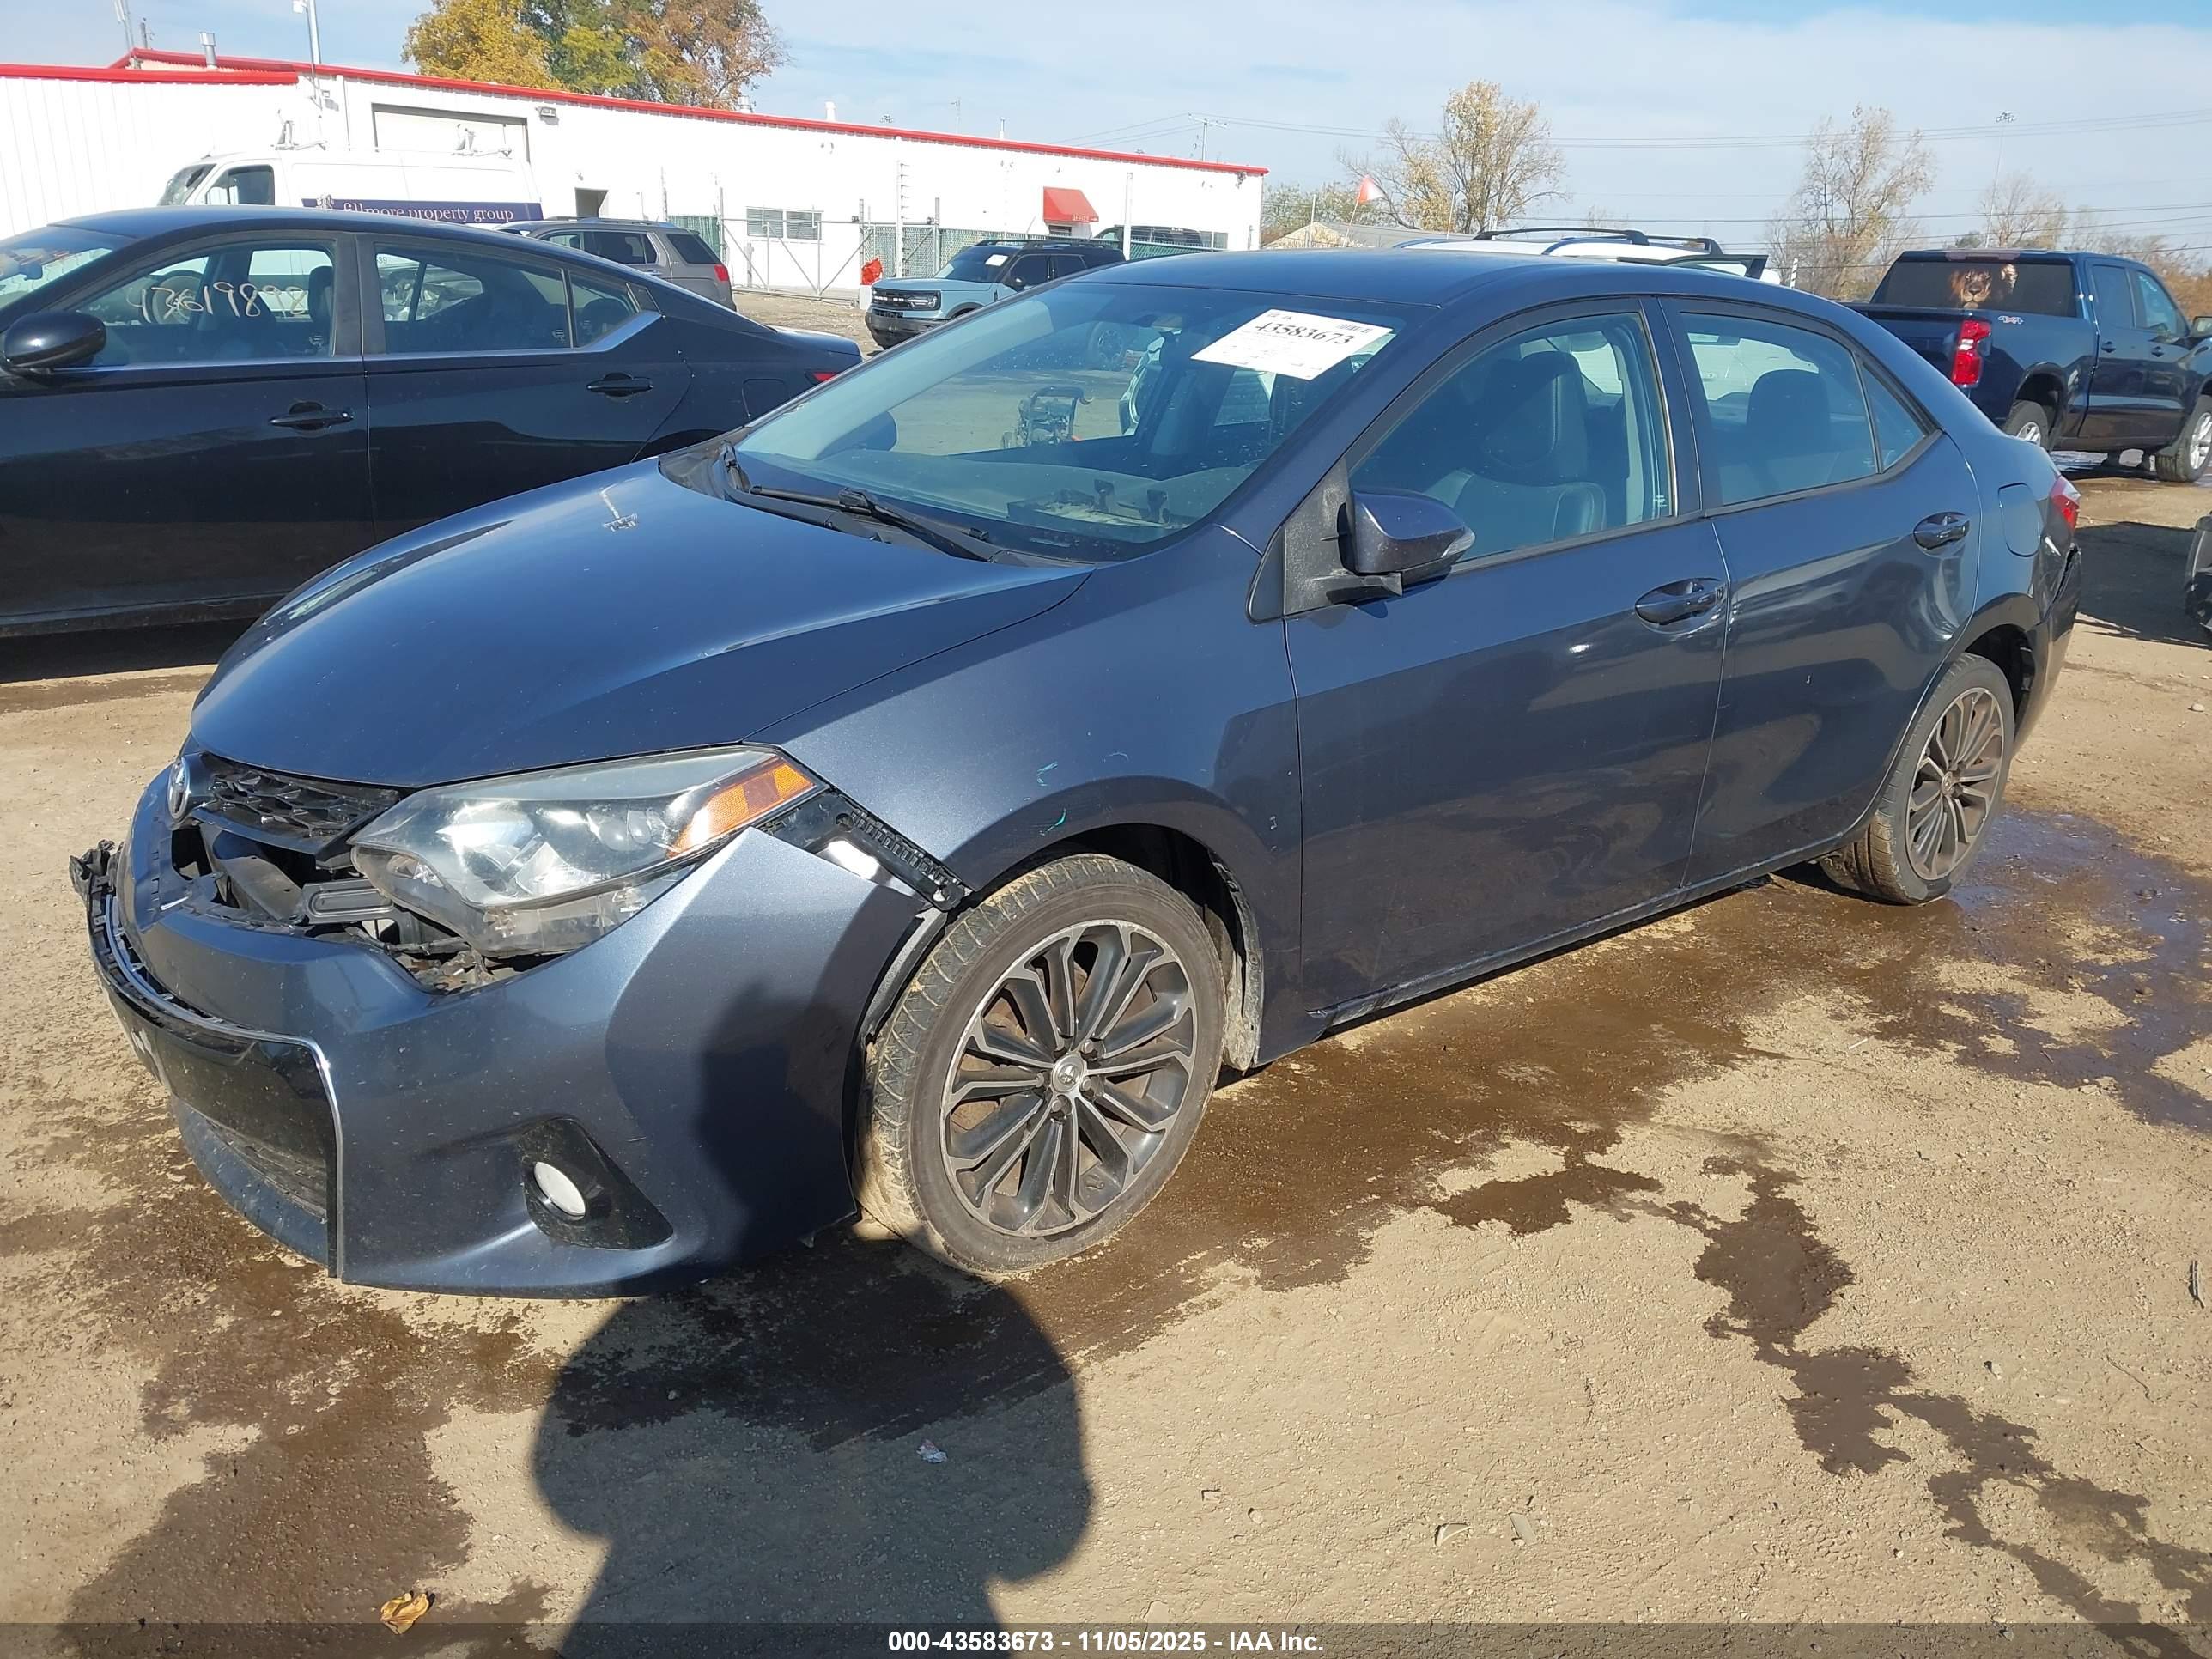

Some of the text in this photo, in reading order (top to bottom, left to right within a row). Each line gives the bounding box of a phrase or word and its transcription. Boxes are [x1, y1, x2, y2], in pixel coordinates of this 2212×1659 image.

[408, 208, 469, 222] property
[473, 209, 514, 223] group
[1255, 321, 1356, 344] 43583673
